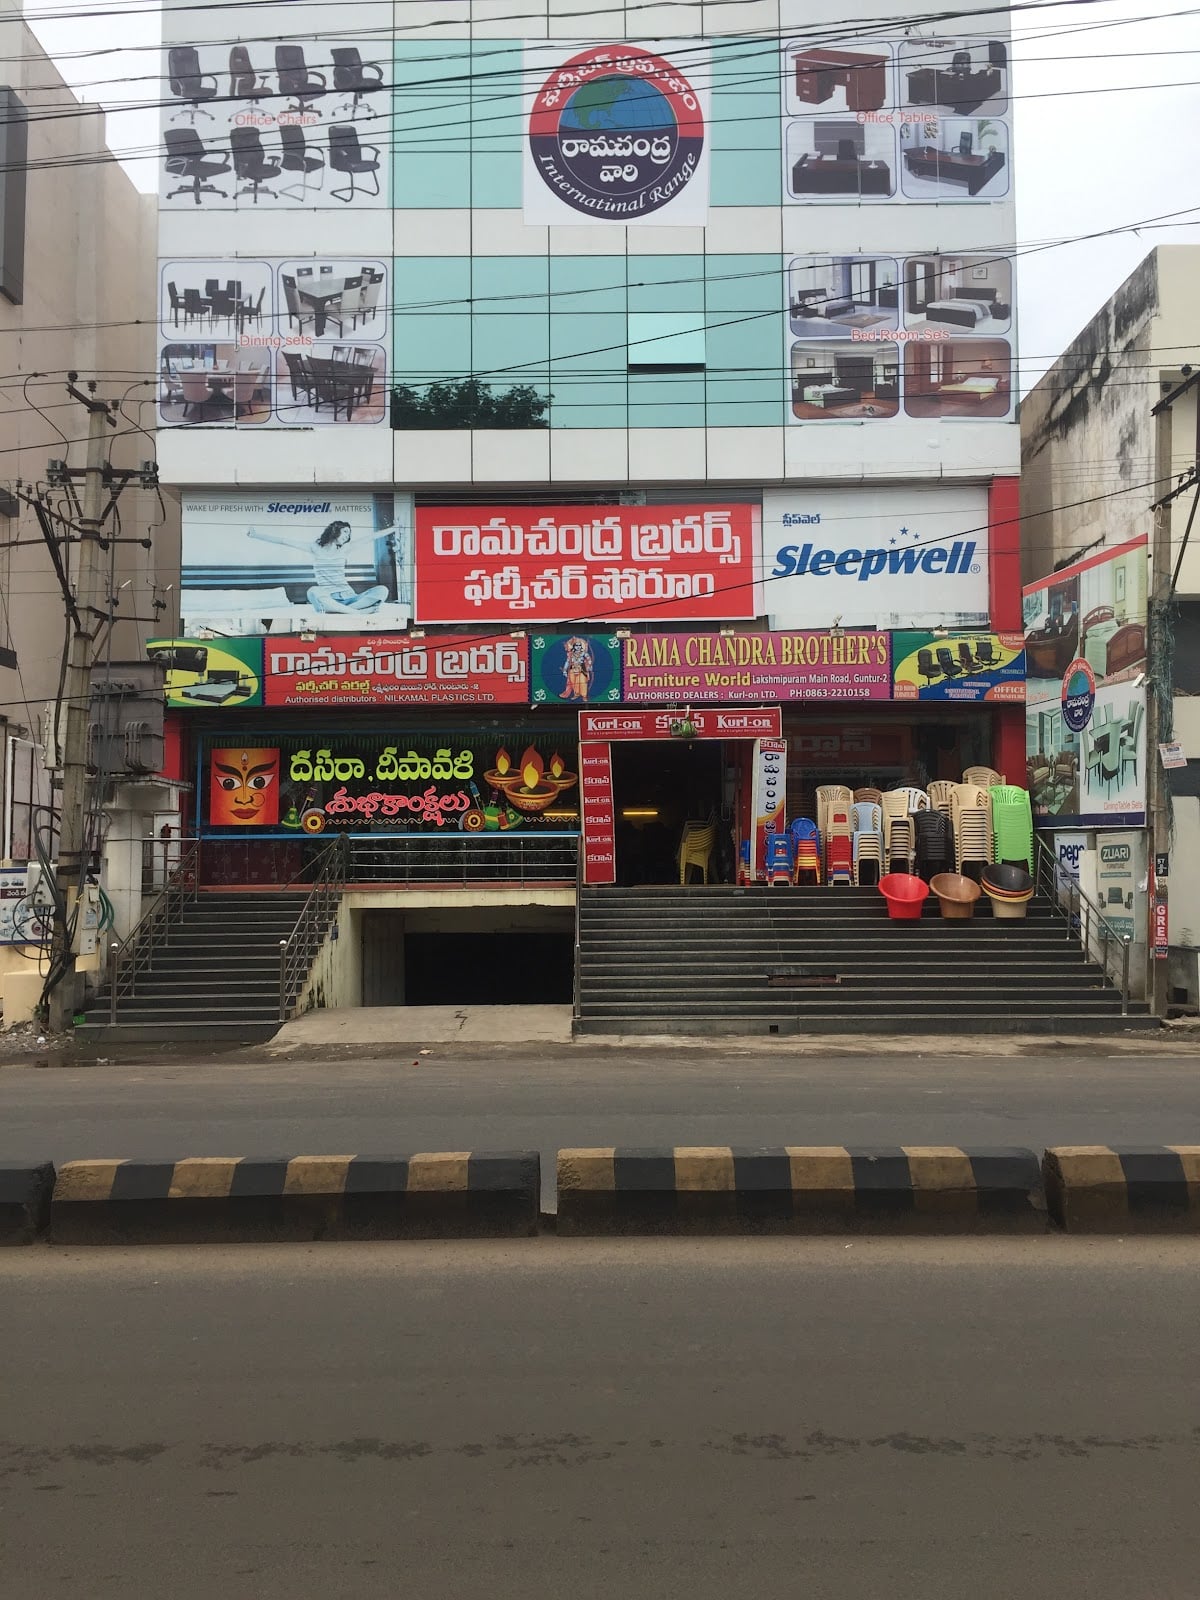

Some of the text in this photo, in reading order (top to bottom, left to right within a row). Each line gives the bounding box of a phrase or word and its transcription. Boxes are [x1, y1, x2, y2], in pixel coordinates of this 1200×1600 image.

[234, 114, 317, 126] Office Chairs
[856, 112, 938, 124] Office Tables
[561, 135, 671, 164] రామచంద్ర
[599, 164, 638, 182] వారి
[649, 152, 696, 204] Range
[240, 336, 313, 348] Dining sets
[851, 330, 876, 341] Bed
[880, 330, 918, 341] Room
[186, 504, 206, 512] WAKE
[208, 504, 219, 512] UP
[220, 504, 243, 512] FRESH
[244, 504, 264, 512] WITH
[267, 502, 331, 514] Sleepwell
[432, 511, 741, 564] రామచంద్ర బ్రదర్స్
[592, 567, 714, 604] షోరూం
[626, 636, 888, 667] RAMA CHANDRA BROTHER'S
[270, 642, 526, 683] రామచంద్ర బ్రదర్స్
[630, 672, 888, 688] Furniture World Lakshmipuram Main Road, Guntur-2
[285, 695, 329, 703] Authorised
[331, 694, 376, 702] distributors
[384, 694, 428, 702] NILKAMAL
[628, 692, 680, 700] AUTHORISED
[682, 691, 718, 699] DEALERS
[728, 690, 758, 698] Kurl-on
[760, 690, 778, 698] LTD.
[790, 688, 870, 698] PH:0863-2210158
[587, 716, 642, 730] Kurl-on
[716, 714, 772, 730] Kurl-on
[376, 746, 474, 781] దీపావళి
[325, 786, 470, 826] శుభాకాంక్షలు
[1102, 848, 1128, 860] ZUARI
[1156, 905, 1166, 937] GRE
